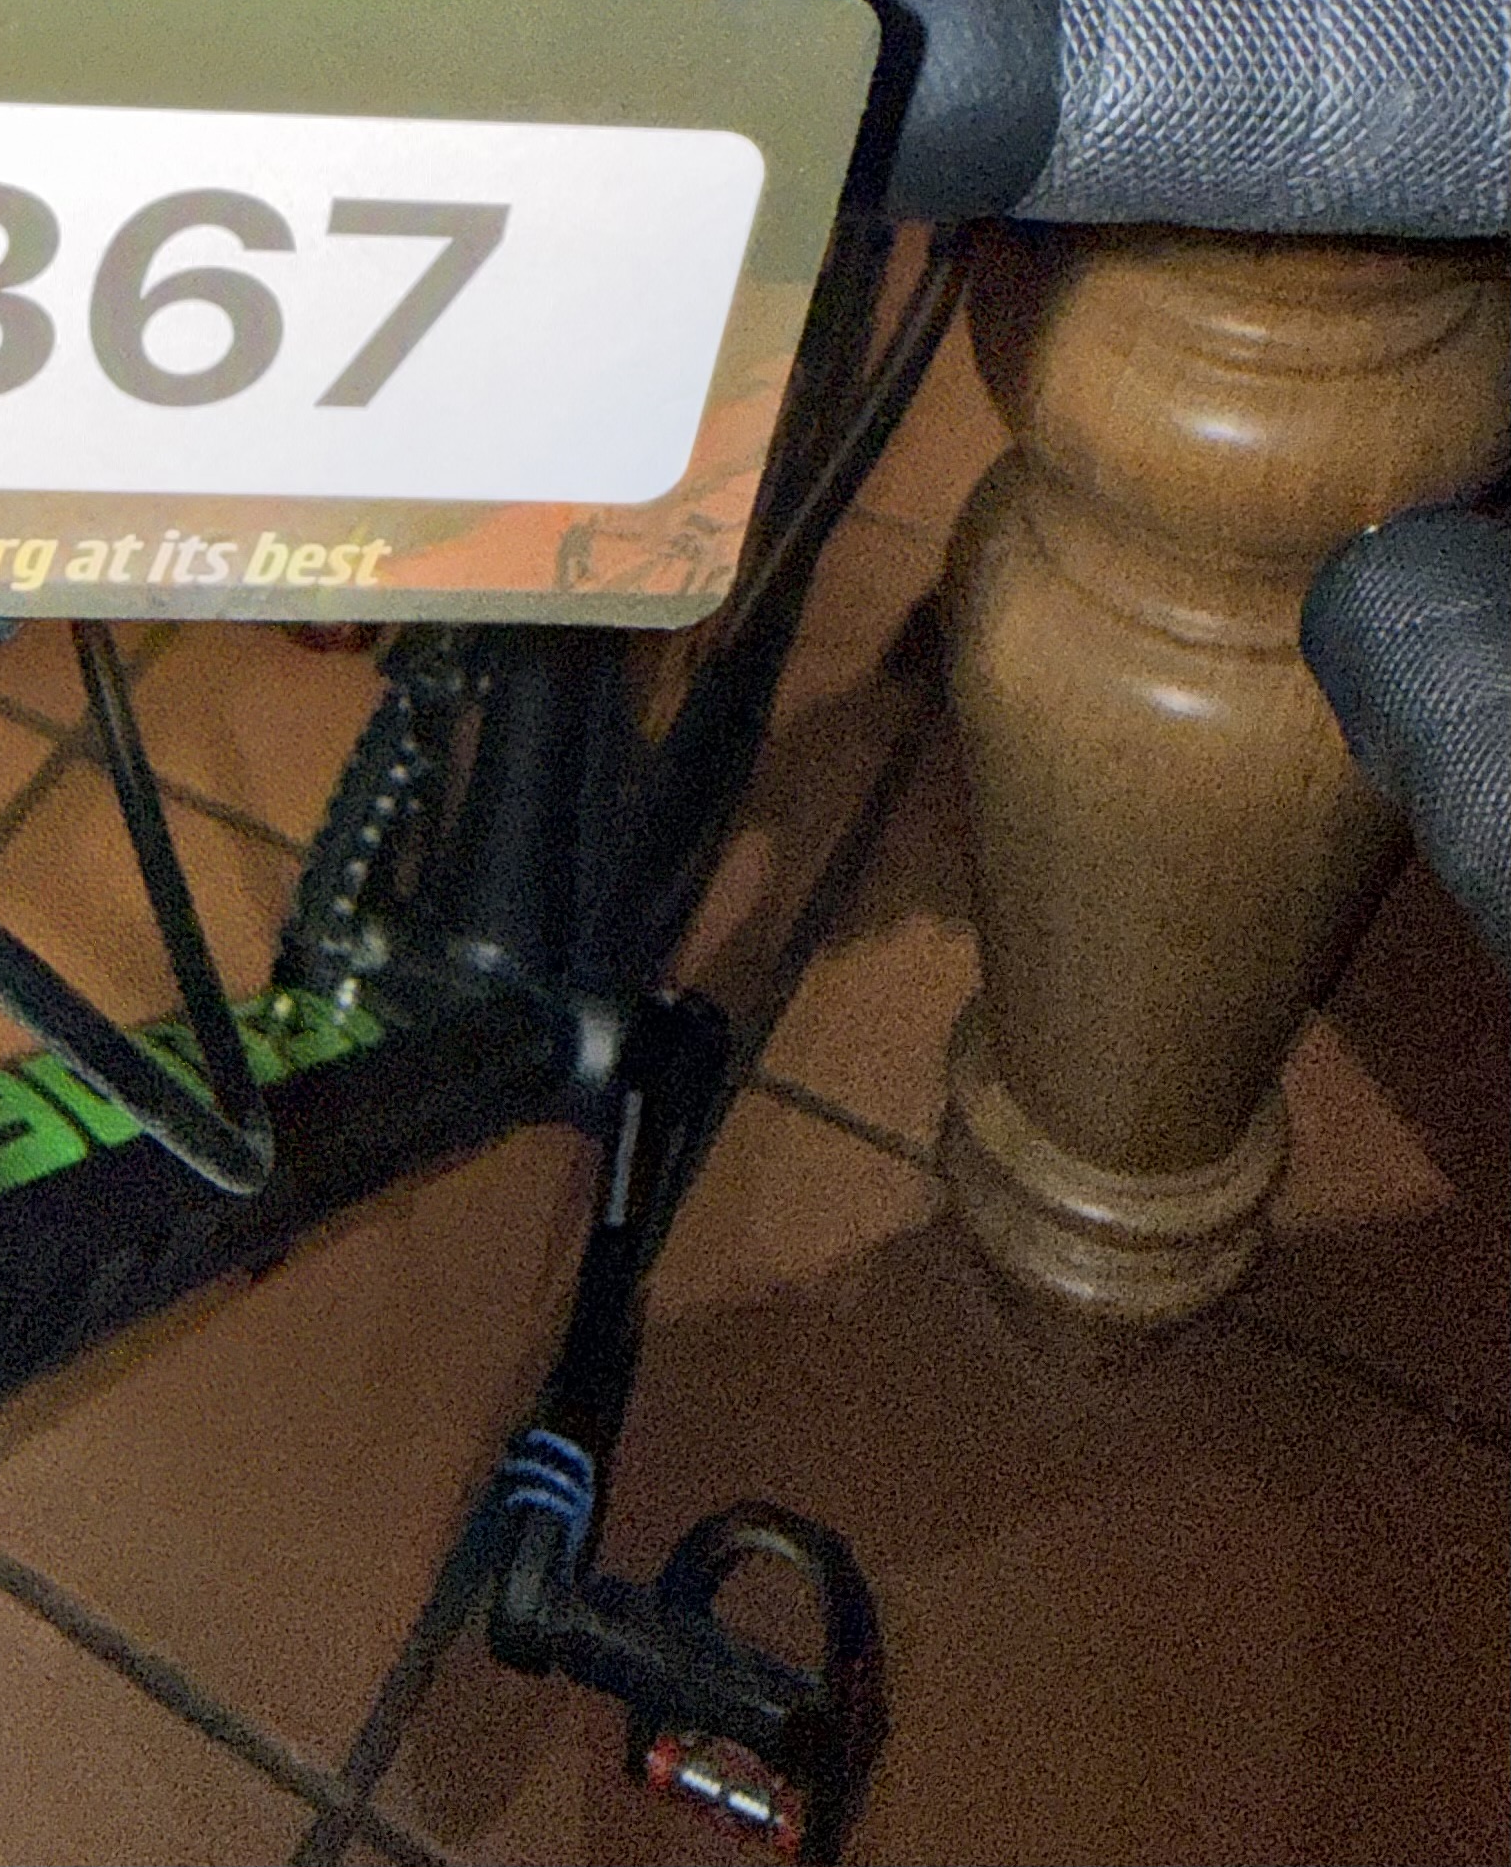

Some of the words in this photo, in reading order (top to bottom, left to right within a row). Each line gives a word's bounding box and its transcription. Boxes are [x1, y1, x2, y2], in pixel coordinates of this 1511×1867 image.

[65, 533, 143, 583] at
[147, 530, 237, 585] its
[243, 531, 392, 588] best
